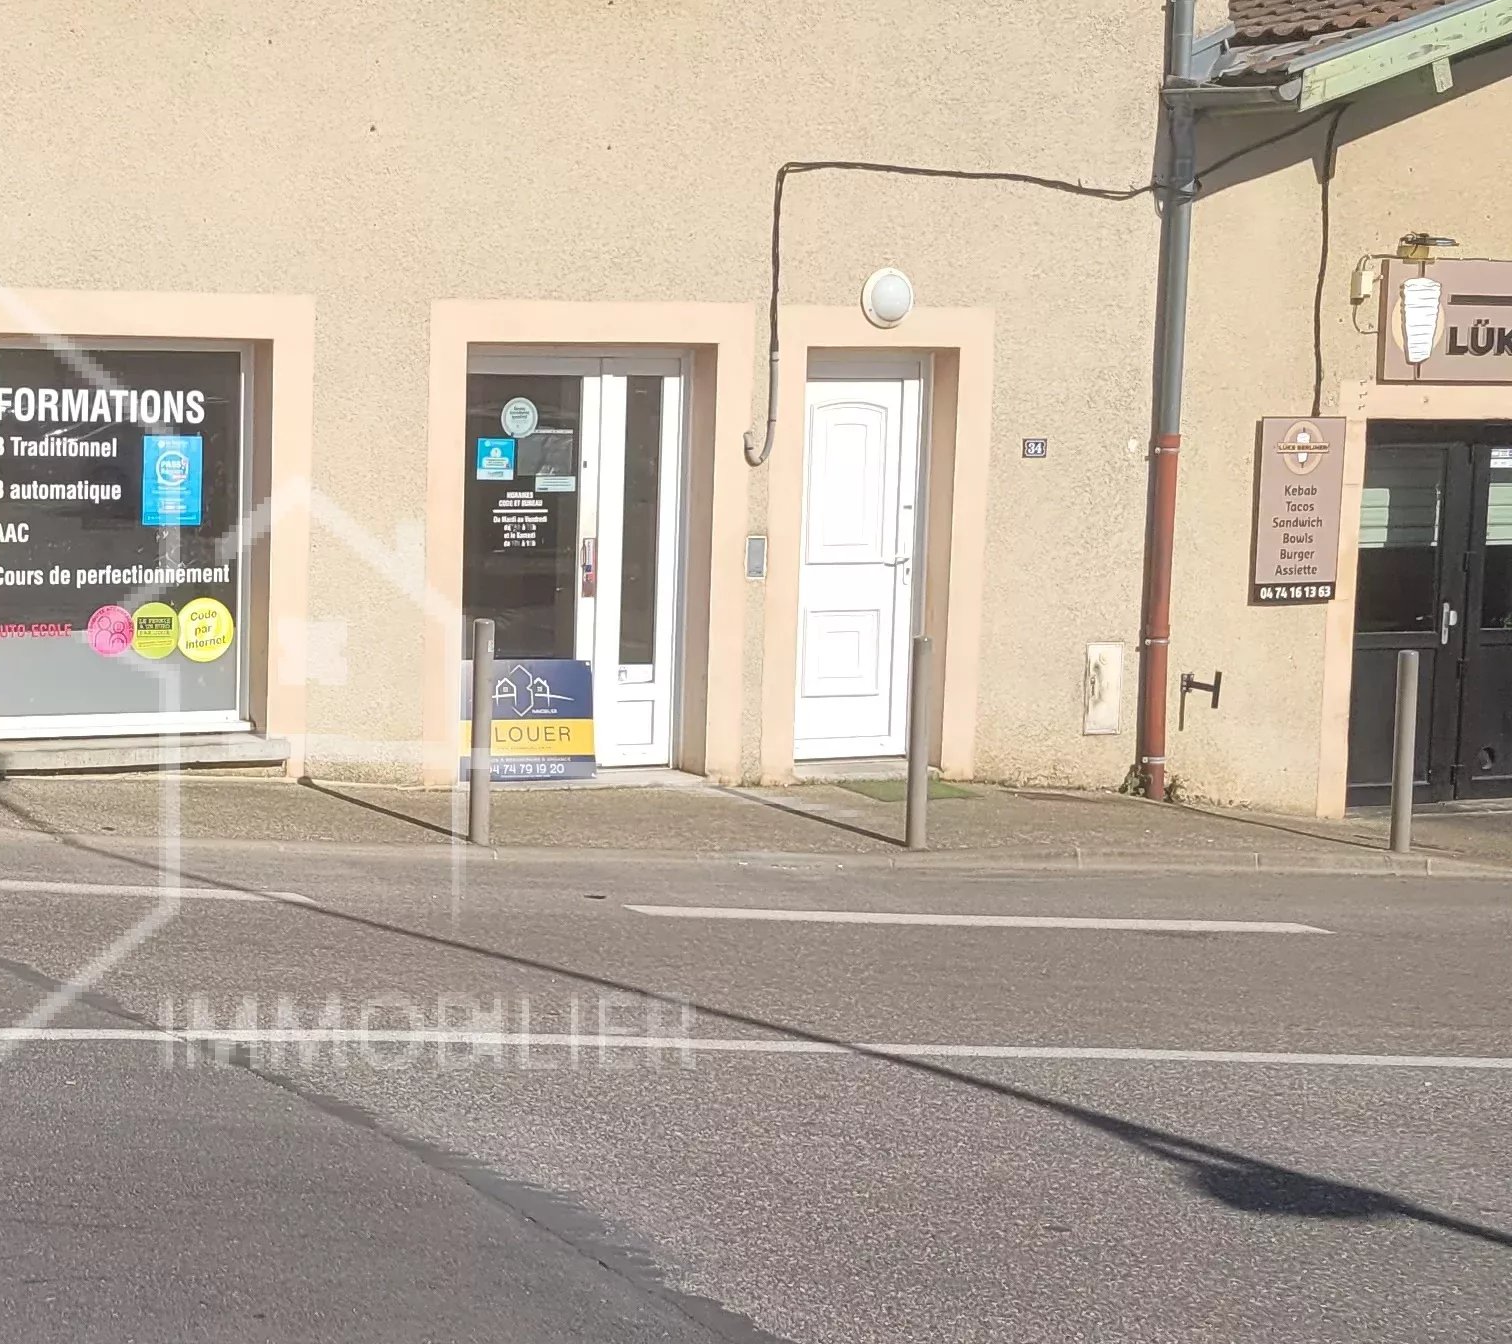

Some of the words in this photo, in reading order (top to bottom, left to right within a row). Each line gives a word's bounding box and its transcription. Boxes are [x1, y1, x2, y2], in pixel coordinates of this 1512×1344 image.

[10, 437, 118, 457] Traditionnel
[1028, 443, 1042, 453] 34
[10, 480, 122, 504] automatique
[1284, 485, 1317, 496] Kebab
[1286, 501, 1314, 512] Tacos
[1272, 517, 1323, 528] Sandwich
[1283, 533, 1313, 544] Bowls
[1280, 549, 1315, 561] Burger
[1275, 565, 1318, 576] Assiette
[49, 566, 71, 585] de
[76, 565, 230, 588] perfectionnement
[1260, 587, 1273, 599] 04
[1275, 587, 1287, 599] 74
[1290, 587, 1302, 598] 16
[1304, 586, 1316, 598] 13
[1318, 586, 1331, 597] 63
[191, 609, 217, 622] Code
[194, 625, 212, 636] par
[494, 726, 570, 742] LOUER
[503, 764, 516, 774] 74
[520, 764, 532, 774] 79
[536, 764, 546, 774] 19
[550, 763, 565, 774] 20
